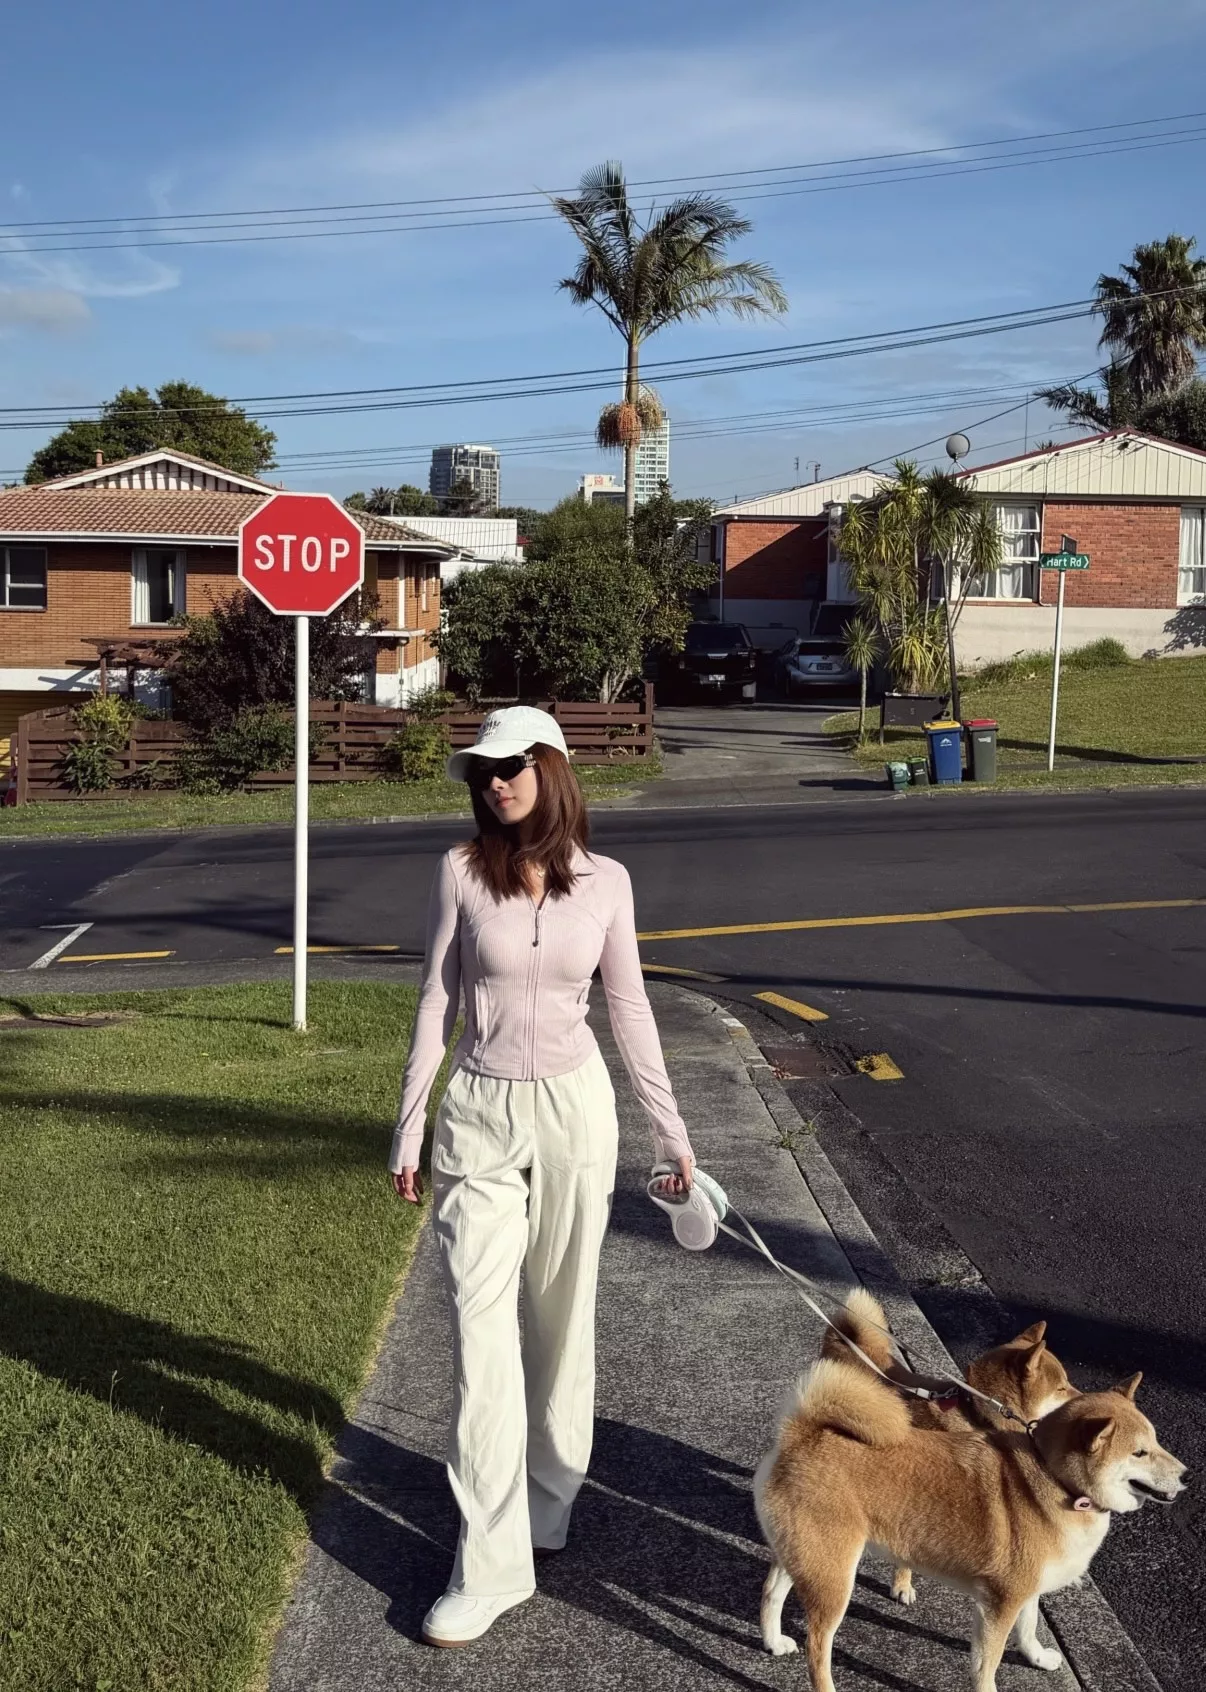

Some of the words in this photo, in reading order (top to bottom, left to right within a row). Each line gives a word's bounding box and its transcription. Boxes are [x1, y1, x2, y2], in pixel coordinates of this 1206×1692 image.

[254, 534, 350, 572] STOP
[1046, 557, 1067, 567] Hart
[1070, 557, 1082, 567] Rd
